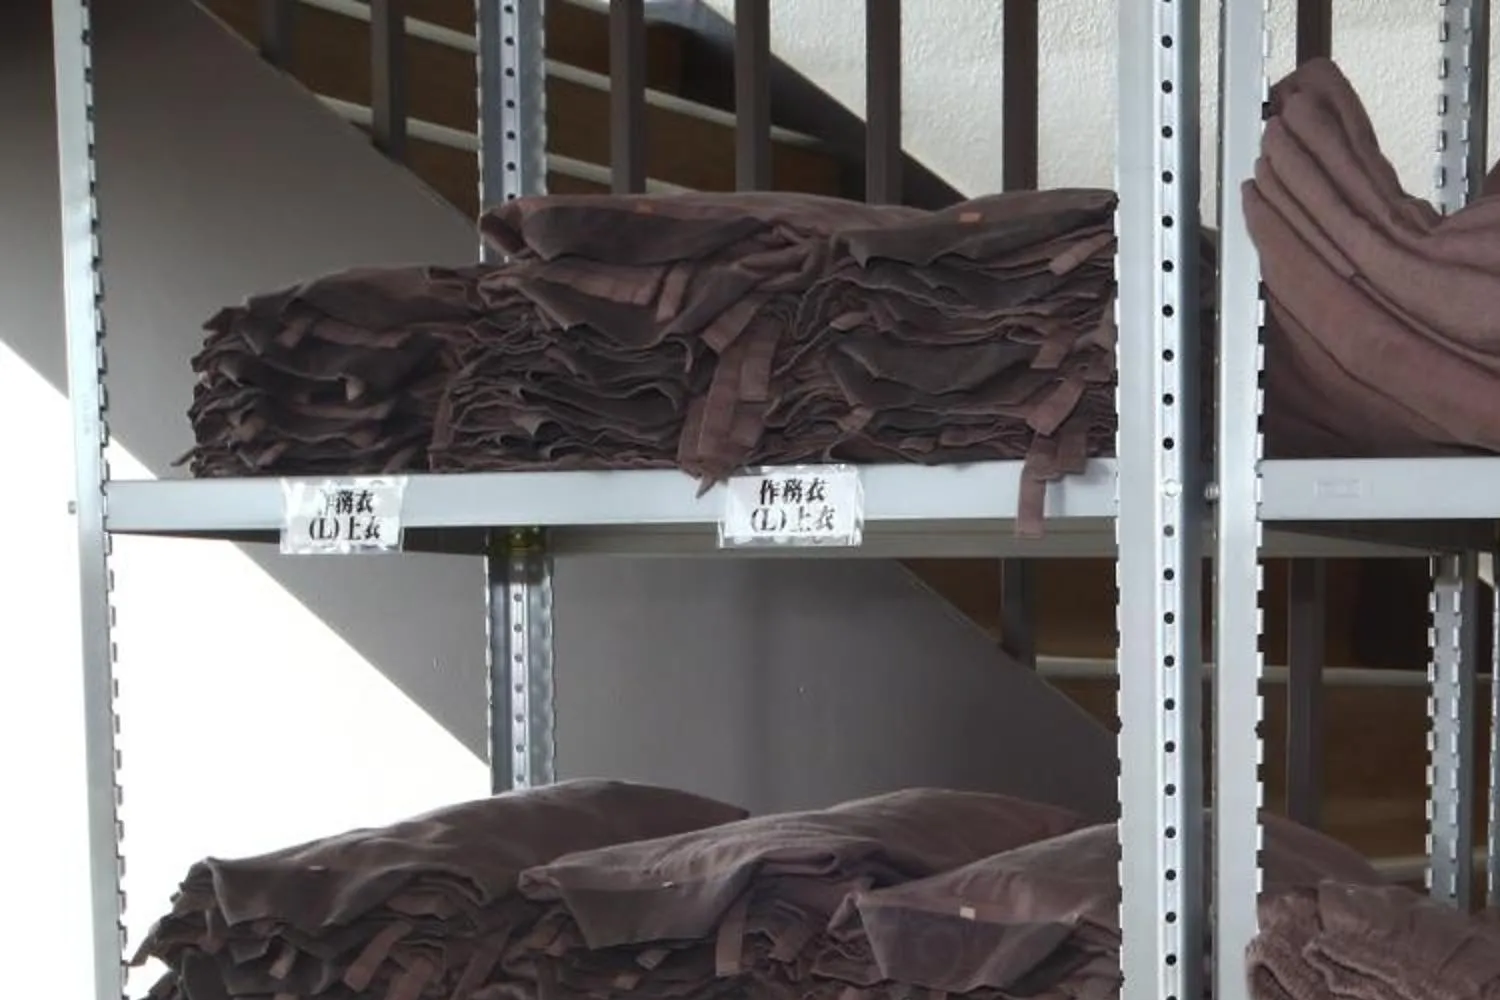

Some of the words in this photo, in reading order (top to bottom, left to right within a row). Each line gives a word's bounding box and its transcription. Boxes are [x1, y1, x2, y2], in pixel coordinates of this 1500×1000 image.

[760, 477, 826, 505] 作務衣
[751, 505, 835, 532] (L)上衣
